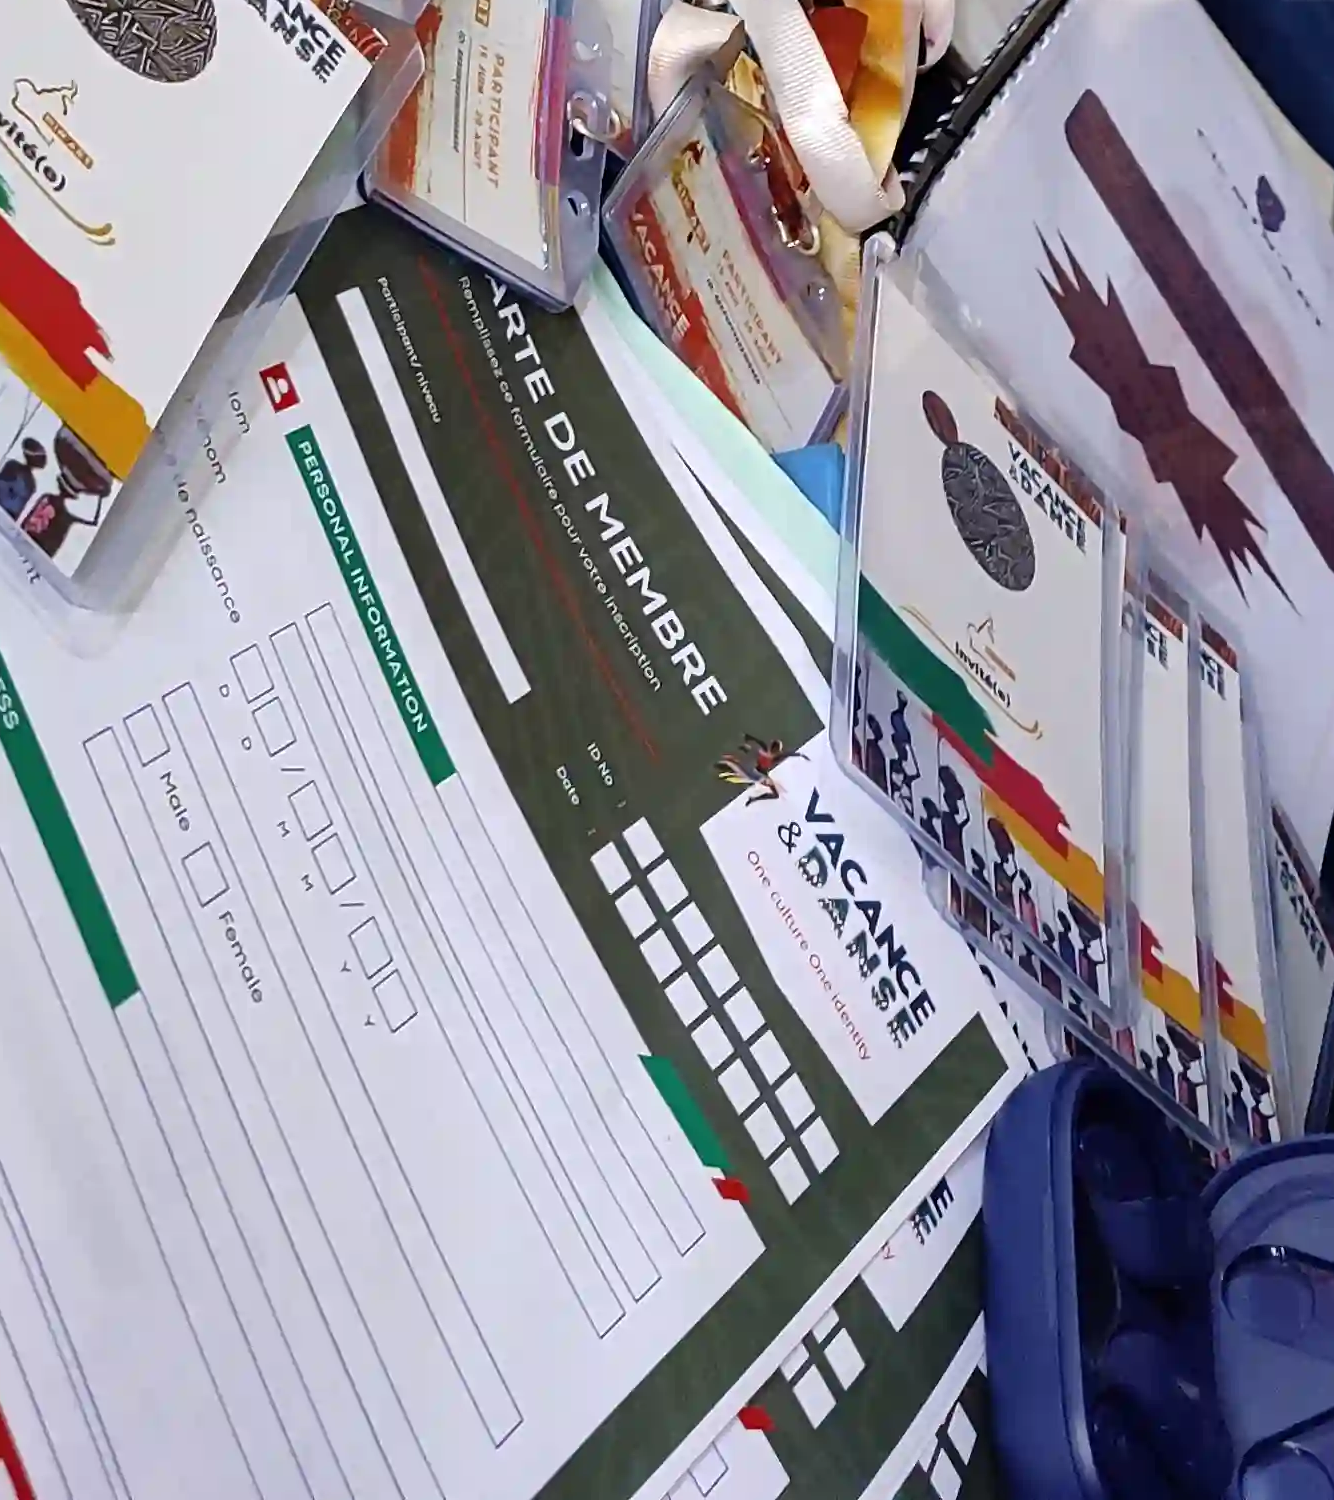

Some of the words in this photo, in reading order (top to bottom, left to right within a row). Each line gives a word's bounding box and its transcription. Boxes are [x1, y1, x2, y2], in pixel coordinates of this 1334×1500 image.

[487, 53, 506, 189] PARTICIPANT
[415, 370, 441, 424] niveau
[459, 275, 503, 380] Remplissez
[510, 406, 559, 501] formulaire
[553, 502, 581, 546] pour
[579, 547, 608, 594] votre
[604, 595, 663, 692] inscription
[485, 273, 555, 404] ARTE
[544, 411, 596, 487] DE
[585, 492, 728, 716] MEMBRE
[1008, 440, 1087, 531] VACANCE
[185, 507, 241, 624] naissance
[297, 439, 353, 564] PERSONAL
[350, 567, 429, 734] INFORMATION
[160, 770, 191, 832] Male
[555, 765, 582, 806] Date
[586, 742, 602, 763] ID
[596, 763, 615, 788] No
[276, 820, 290, 838] M
[300, 874, 315, 892] M
[805, 787, 936, 1028] VACANCE
[218, 909, 264, 1004] Female
[747, 849, 772, 888] One
[769, 889, 810, 953] culture
[808, 953, 833, 994] One
[830, 994, 872, 1062] identity
[777, 820, 802, 853] &
[796, 845, 916, 1050] DANSE
